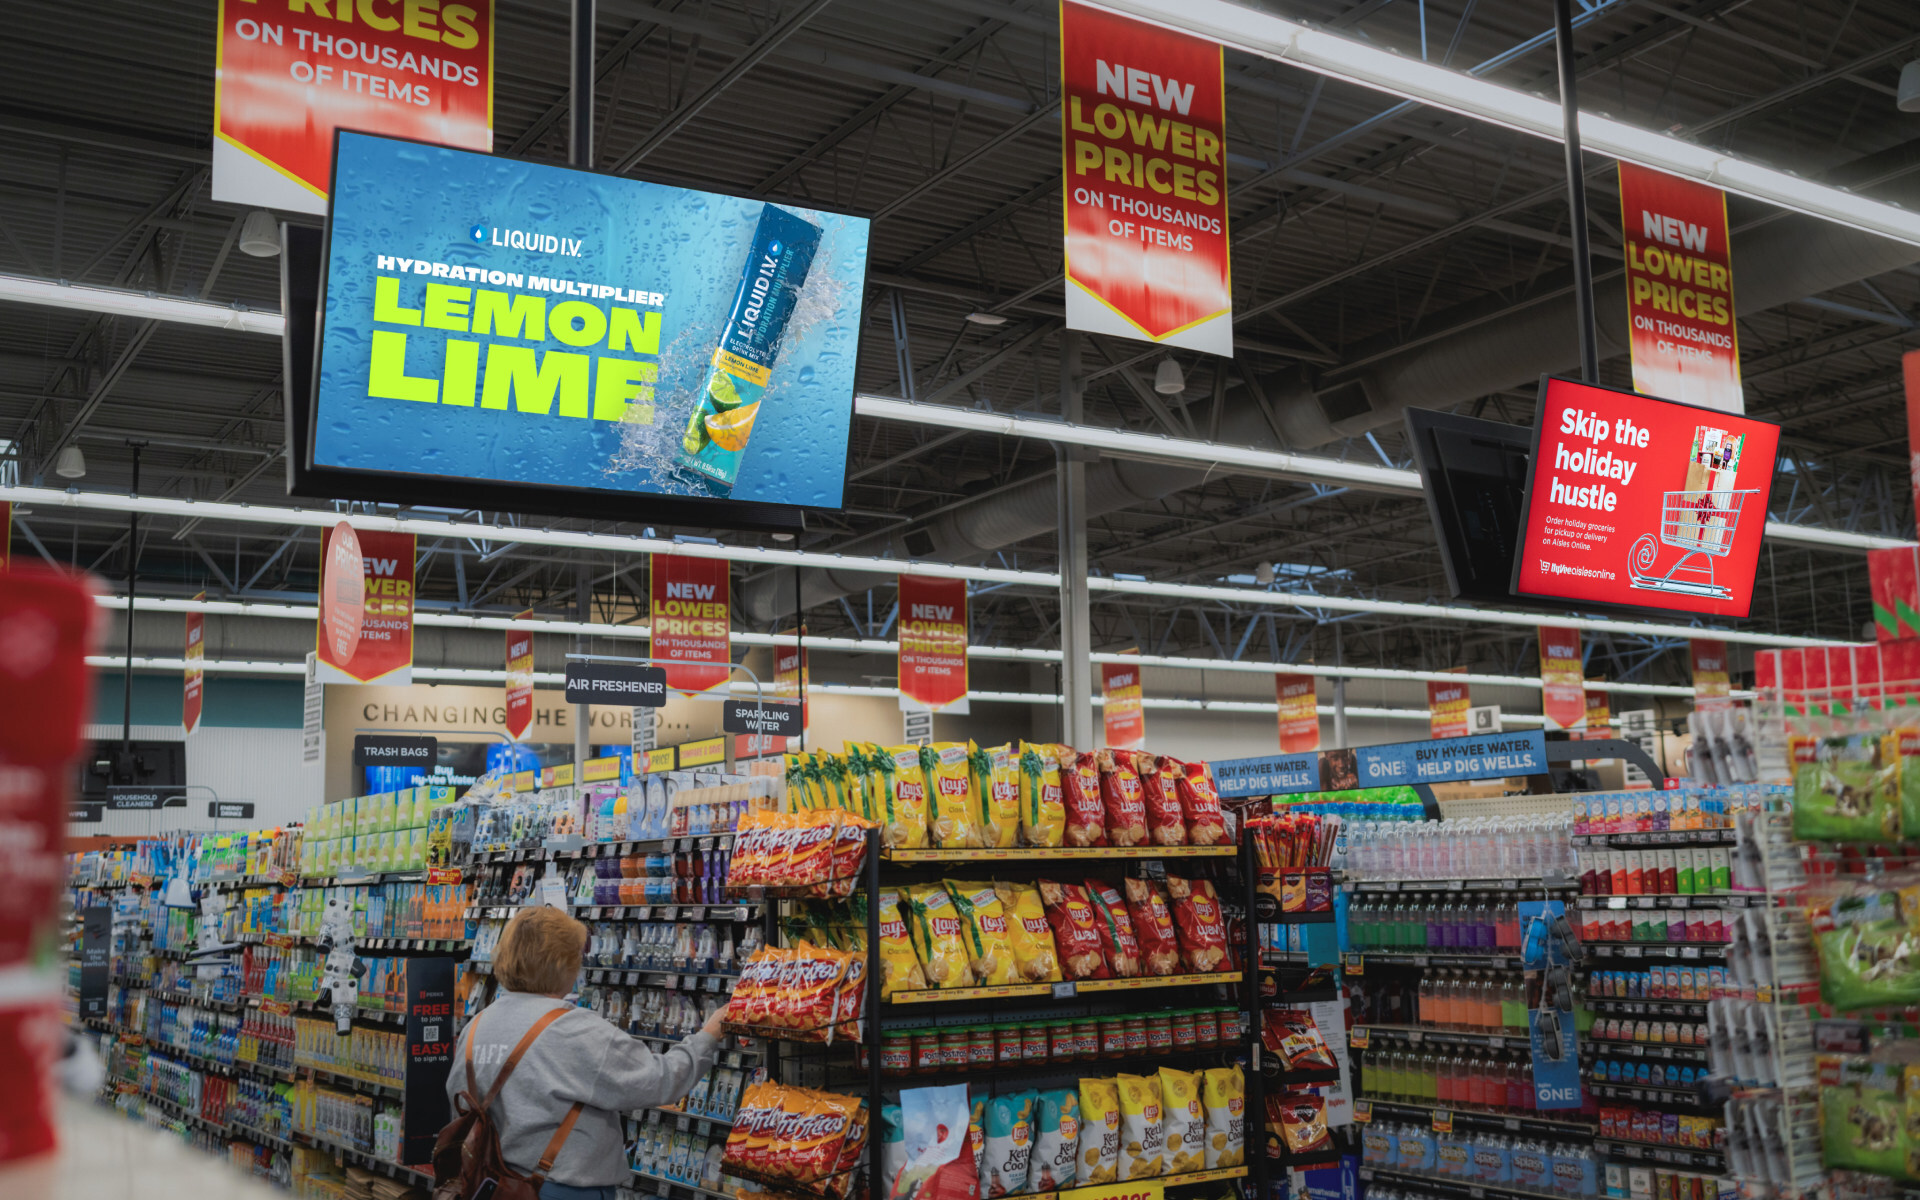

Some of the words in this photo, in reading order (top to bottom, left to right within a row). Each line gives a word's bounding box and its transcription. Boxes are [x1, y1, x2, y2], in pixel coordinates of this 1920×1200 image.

[235, 18, 284, 46] ON
[292, 27, 480, 87] THOUSANDS
[290, 60, 334, 86] OF
[342, 69, 431, 107] ITEMS
[1096, 58, 1196, 116] NEW
[1070, 95, 1222, 167] LOWER
[1074, 139, 1221, 206] PRICES
[1073, 187, 1105, 209] ON
[1108, 193, 1222, 236] THOUSANDS
[1108, 219, 1135, 239] OF
[1140, 225, 1194, 252] ITEMS
[1642, 209, 1709, 254] NEW
[491, 227, 559, 255] LIQUID
[559, 237, 583, 259] I.V.
[1628, 239, 1729, 293] LOWER
[376, 254, 524, 289] HYDRATION
[527, 275, 666, 308] MULTIPLIER
[738, 276, 770, 339] LIQUID
[1632, 276, 1730, 326] PRICES
[372, 275, 663, 356] LEMON
[1634, 314, 1654, 332] ON
[1656, 319, 1732, 349] THOUSANDS
[1656, 340, 1675, 355] OF
[724, 355, 745, 368] LEMON
[744, 362, 760, 374] LIME
[367, 328, 660, 426] LIME
[1559, 407, 1610, 445] Skip
[1615, 418, 1651, 449] the
[1554, 441, 1638, 487] holiday
[1549, 476, 1618, 512] hustle
[1546, 515, 1565, 526] Order
[1564, 518, 1587, 531] holiday
[1587, 523, 1616, 533] groceries
[1544, 526, 1554, 535] for
[1554, 528, 1575, 539] pickup
[1576, 532, 1584, 540] or
[1583, 532, 1608, 543] delivery
[1542, 537, 1551, 546] on
[1552, 538, 1570, 549] Aisles
[1571, 541, 1592, 551] Online.
[361, 556, 398, 577] EW
[363, 577, 412, 597] WER
[665, 581, 716, 601] NEW
[654, 599, 728, 619] LOWER
[911, 602, 955, 621] NEW
[655, 617, 727, 637] PRICES
[901, 618, 965, 639] LOWER
[510, 639, 529, 659] NEW
[655, 637, 670, 648] ON
[671, 638, 727, 650] THOUSANDS
[902, 636, 964, 656] PRICES
[1548, 645, 1574, 658] NEW
[670, 649, 683, 659] OF
[684, 649, 712, 660] ITEMS
[901, 655, 915, 665] ON
[915, 655, 964, 667] THOUSANDS
[915, 665, 927, 675] OF
[927, 665, 952, 676] ITEMS
[1542, 658, 1581, 671] LOWER
[567, 678, 590, 690] AIR
[591, 679, 664, 694] FRESHENER
[1109, 672, 1133, 688] NEW
[1283, 682, 1308, 697] NEW
[1435, 688, 1462, 701] NEW
[363, 702, 507, 726] CHANGING
[536, 708, 567, 727] HE
[1479, 712, 1487, 726] 6
[364, 746, 399, 758] TRASH
[400, 747, 429, 758] BAGS
[652, 753, 671, 765] PRICE!
[1416, 749, 1439, 761] BUY
[1442, 744, 1485, 758] HY-VEE
[1486, 739, 1535, 754] WATER.
[433, 765, 454, 776] Buy
[1218, 766, 1237, 778] BUY
[1238, 763, 1273, 776] HY-VEE
[1274, 760, 1311, 773] WATER.
[1368, 760, 1402, 777] ONE
[1417, 761, 1451, 776] HELP
[1454, 759, 1480, 774] DIG
[1482, 753, 1537, 770] WELLS.
[411, 774, 447, 787] Hy-Vee
[447, 775, 477, 786] Water
[940, 776, 968, 797] Lay's
[1219, 778, 1247, 792] HELP
[1249, 776, 1269, 789] DIG
[1269, 773, 1313, 787] WELLS.
[113, 793, 158, 802] HOUSEHOLD
[898, 780, 924, 802] Lay's
[116, 800, 155, 809] CLEANERS
[219, 804, 244, 813] ENERGY
[791, 823, 836, 850] Fritos
[446, 870, 461, 878] LOW
[1068, 904, 1092, 922] Lay's
[1194, 902, 1214, 918] Lay's
[934, 916, 961, 935] Lay's
[982, 914, 1008, 932] Lay's
[1022, 915, 1049, 934] Lay's
[86, 947, 107, 955] Make
[89, 954, 102, 962] the
[82, 960, 108, 969] switch.
[792, 958, 842, 987] Fritos
[412, 1003, 450, 1017] FREE
[420, 1015, 429, 1023] to
[411, 1042, 450, 1056] EASY
[473, 1044, 509, 1065] TAFF
[423, 1055, 438, 1064] sign
[439, 1055, 449, 1063] up.
[1538, 1089, 1574, 1102] ONE
[794, 1114, 847, 1140] Fritos
[1014, 1124, 1029, 1138] Lay's
[1060, 1120, 1077, 1134] Lay's
[1474, 1152, 1502, 1165] splash
[1513, 1155, 1545, 1169] splash
[1552, 1163, 1584, 1176] splash
